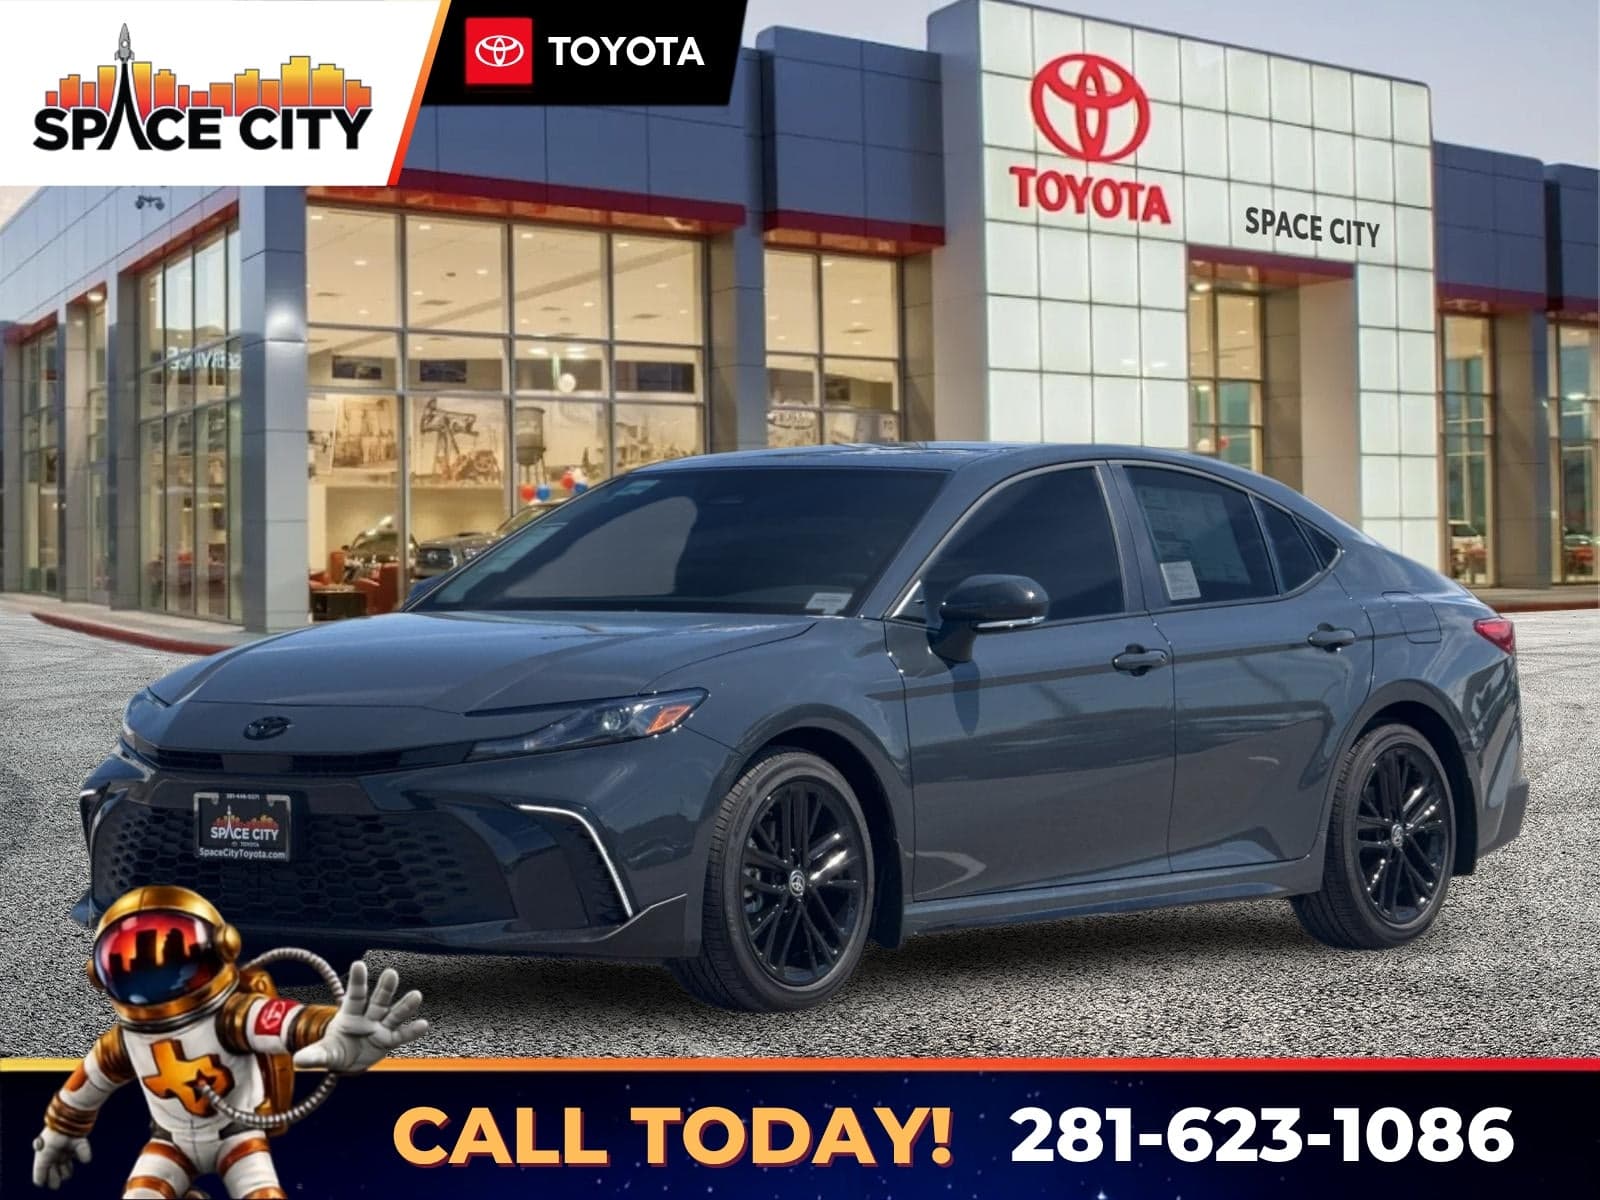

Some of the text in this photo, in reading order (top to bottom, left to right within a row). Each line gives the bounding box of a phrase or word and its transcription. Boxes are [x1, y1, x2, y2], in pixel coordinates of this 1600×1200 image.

[1008, 166, 1171, 225] TOYOTA
[1245, 206, 1381, 249] SPACE CITY
[210, 823, 280, 841] SPACE CITY
[199, 847, 286, 860] SpaceCityToyota.com
